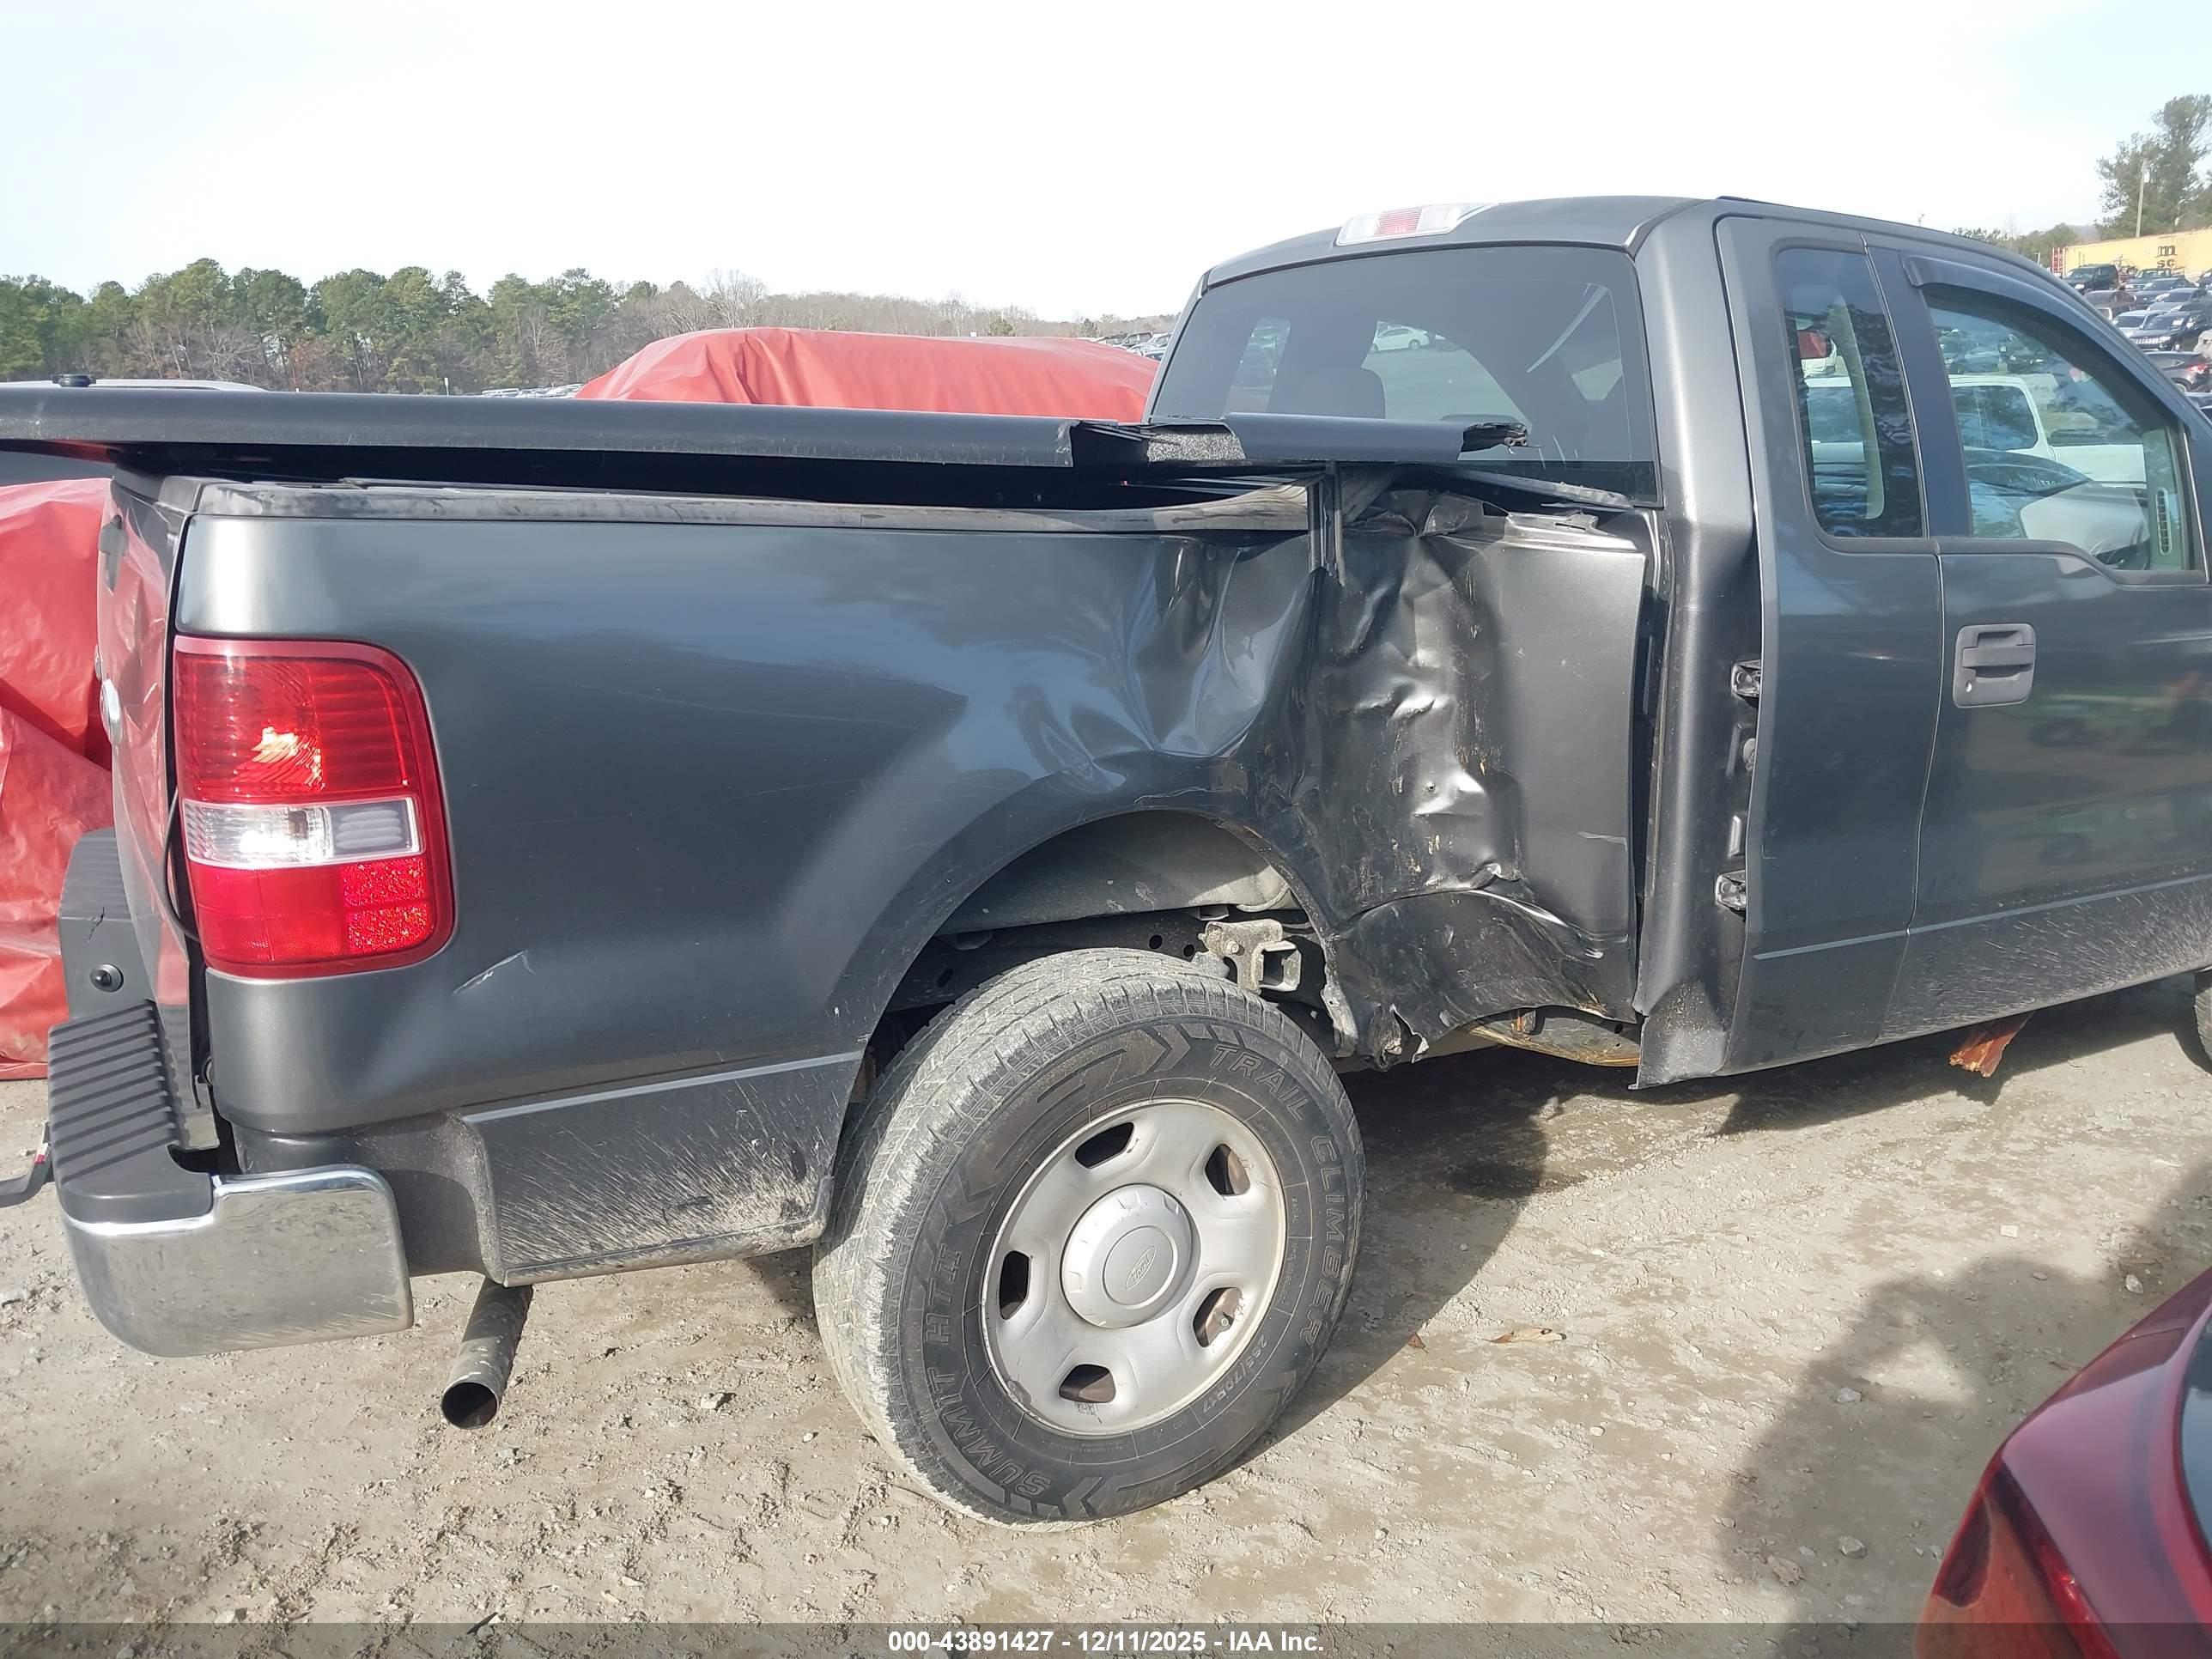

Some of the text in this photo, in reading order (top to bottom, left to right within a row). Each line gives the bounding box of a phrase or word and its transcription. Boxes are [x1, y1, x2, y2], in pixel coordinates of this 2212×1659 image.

[1209, 1044, 1310, 1121] TRAIL
[1299, 1135, 1346, 1346] CLIMBER
[1129, 1251, 1152, 1285] Ford
[1203, 1334, 1267, 1413] 265/70R17
[927, 1366, 1052, 1496] SUMMIT
